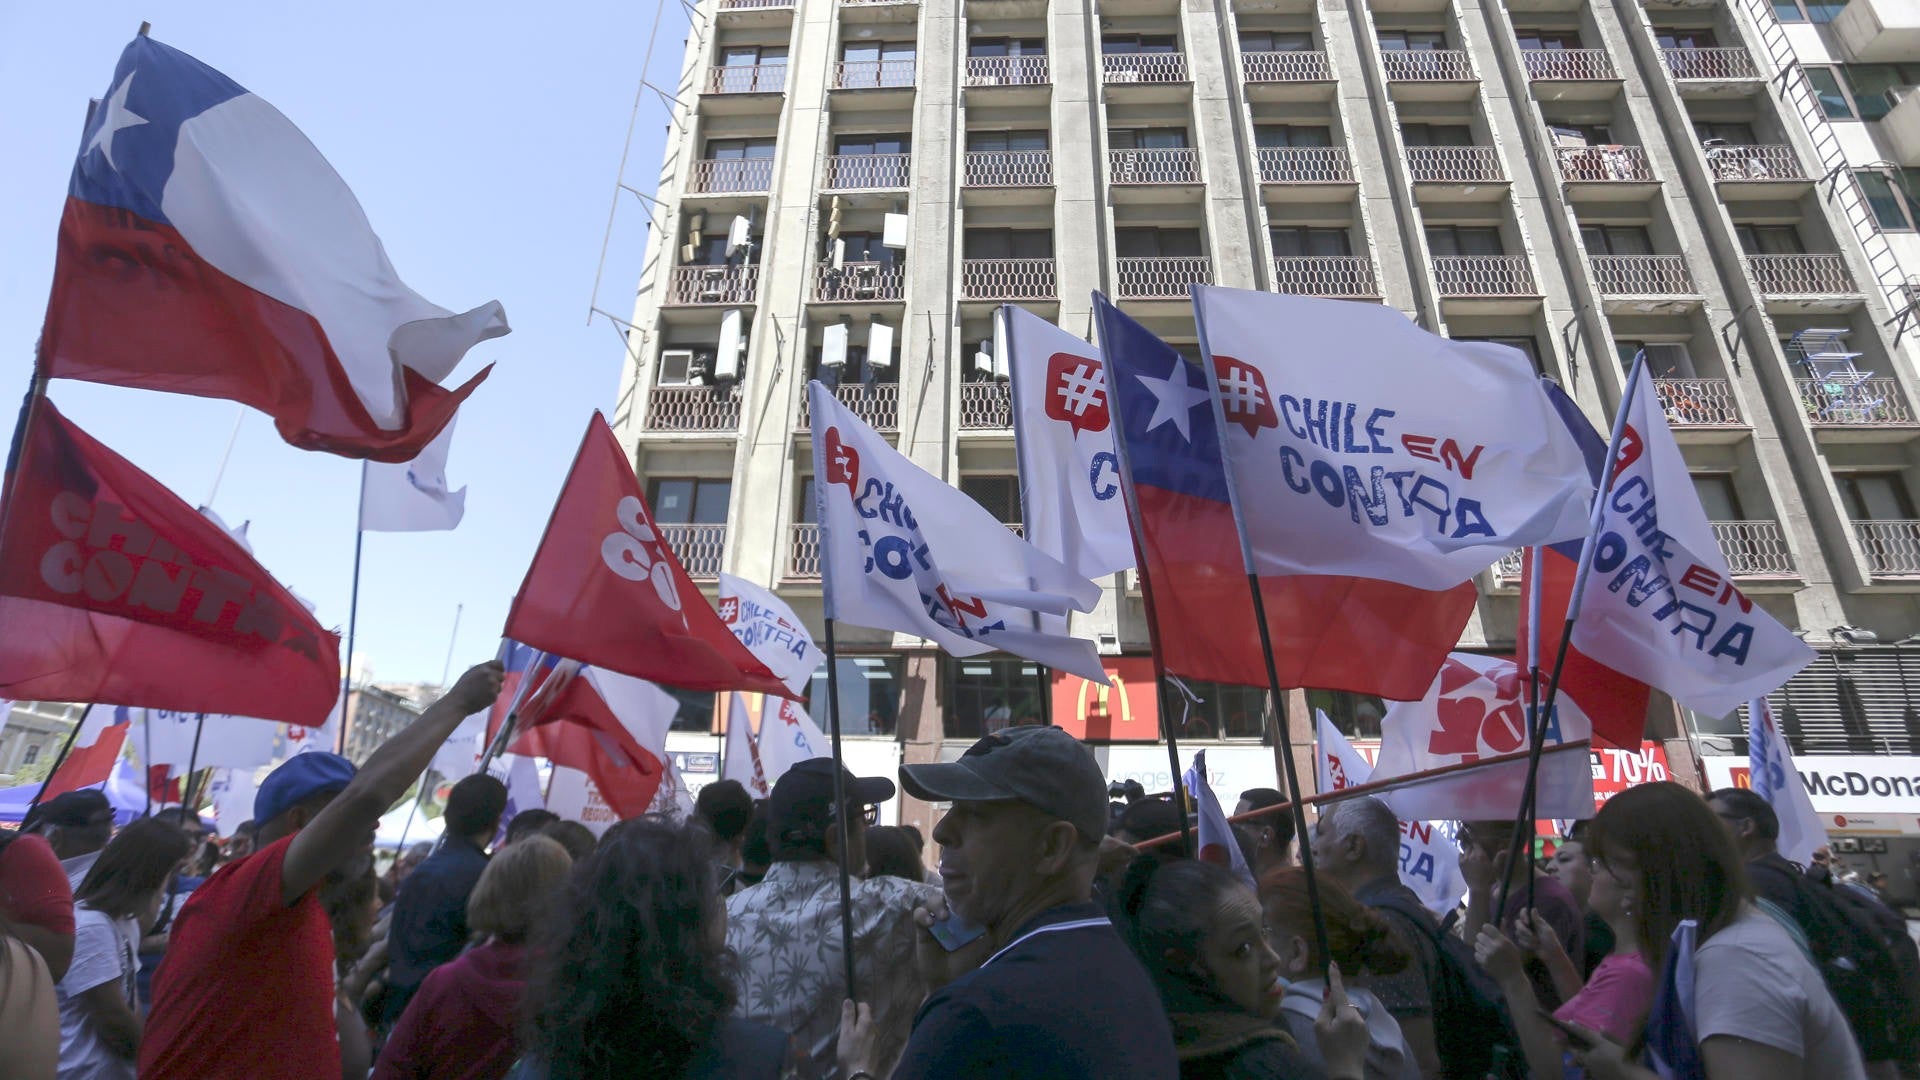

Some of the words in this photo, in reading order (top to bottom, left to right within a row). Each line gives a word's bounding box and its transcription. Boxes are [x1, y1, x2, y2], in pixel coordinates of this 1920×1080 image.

[1279, 394, 1396, 455] CHILE
[1402, 433, 1485, 480] EN
[1279, 445, 1498, 538] CONTRA
[1593, 530, 1755, 666] ONTRA
[1603, 747, 1666, 783] 70%
